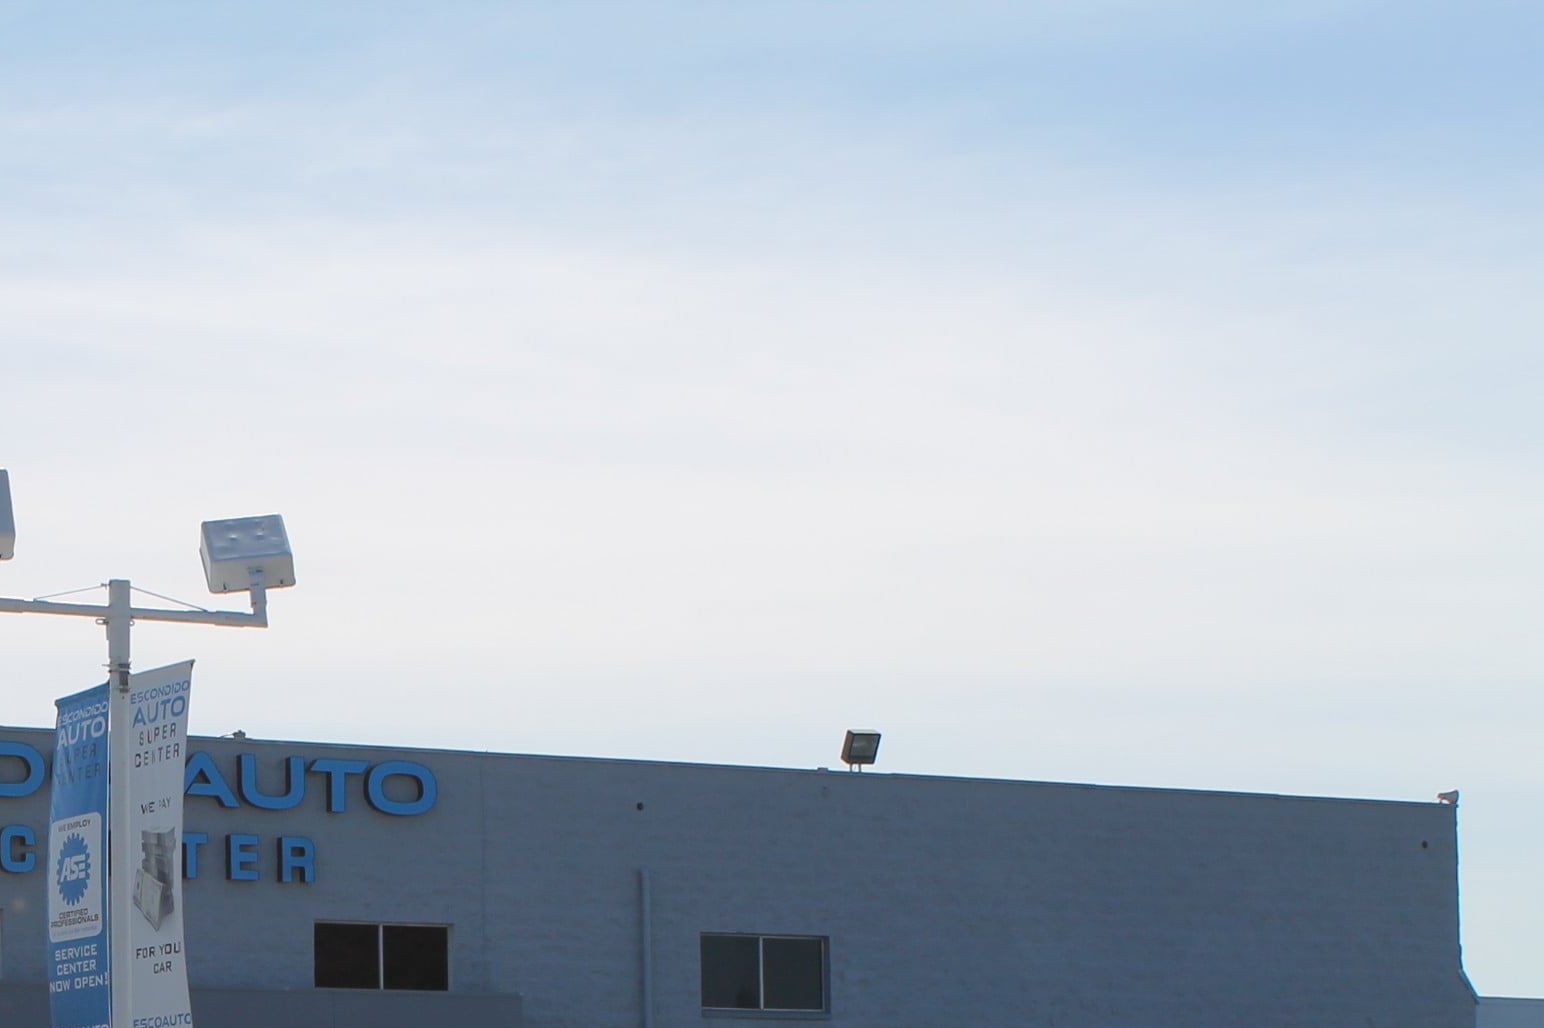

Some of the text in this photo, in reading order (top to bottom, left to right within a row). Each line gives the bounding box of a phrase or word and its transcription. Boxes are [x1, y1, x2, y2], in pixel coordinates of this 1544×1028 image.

[131, 680, 190, 704] ESCONDIDO
[133, 695, 186, 728] AUTO
[57, 716, 106, 750] AUTO
[140, 722, 176, 746] SUPER
[135, 743, 179, 768] CENTER
[184, 752, 438, 816] AUTO
[141, 802, 155, 815] WE
[66, 819, 91, 830] EMPLOY
[60, 854, 86, 882] ASE
[55, 944, 97, 961] SERVICE
[136, 946, 155, 960] FOR
[56, 960, 96, 976] CENTER
[153, 961, 172, 974] CAR
[50, 972, 108, 993] NOW OPEN!
